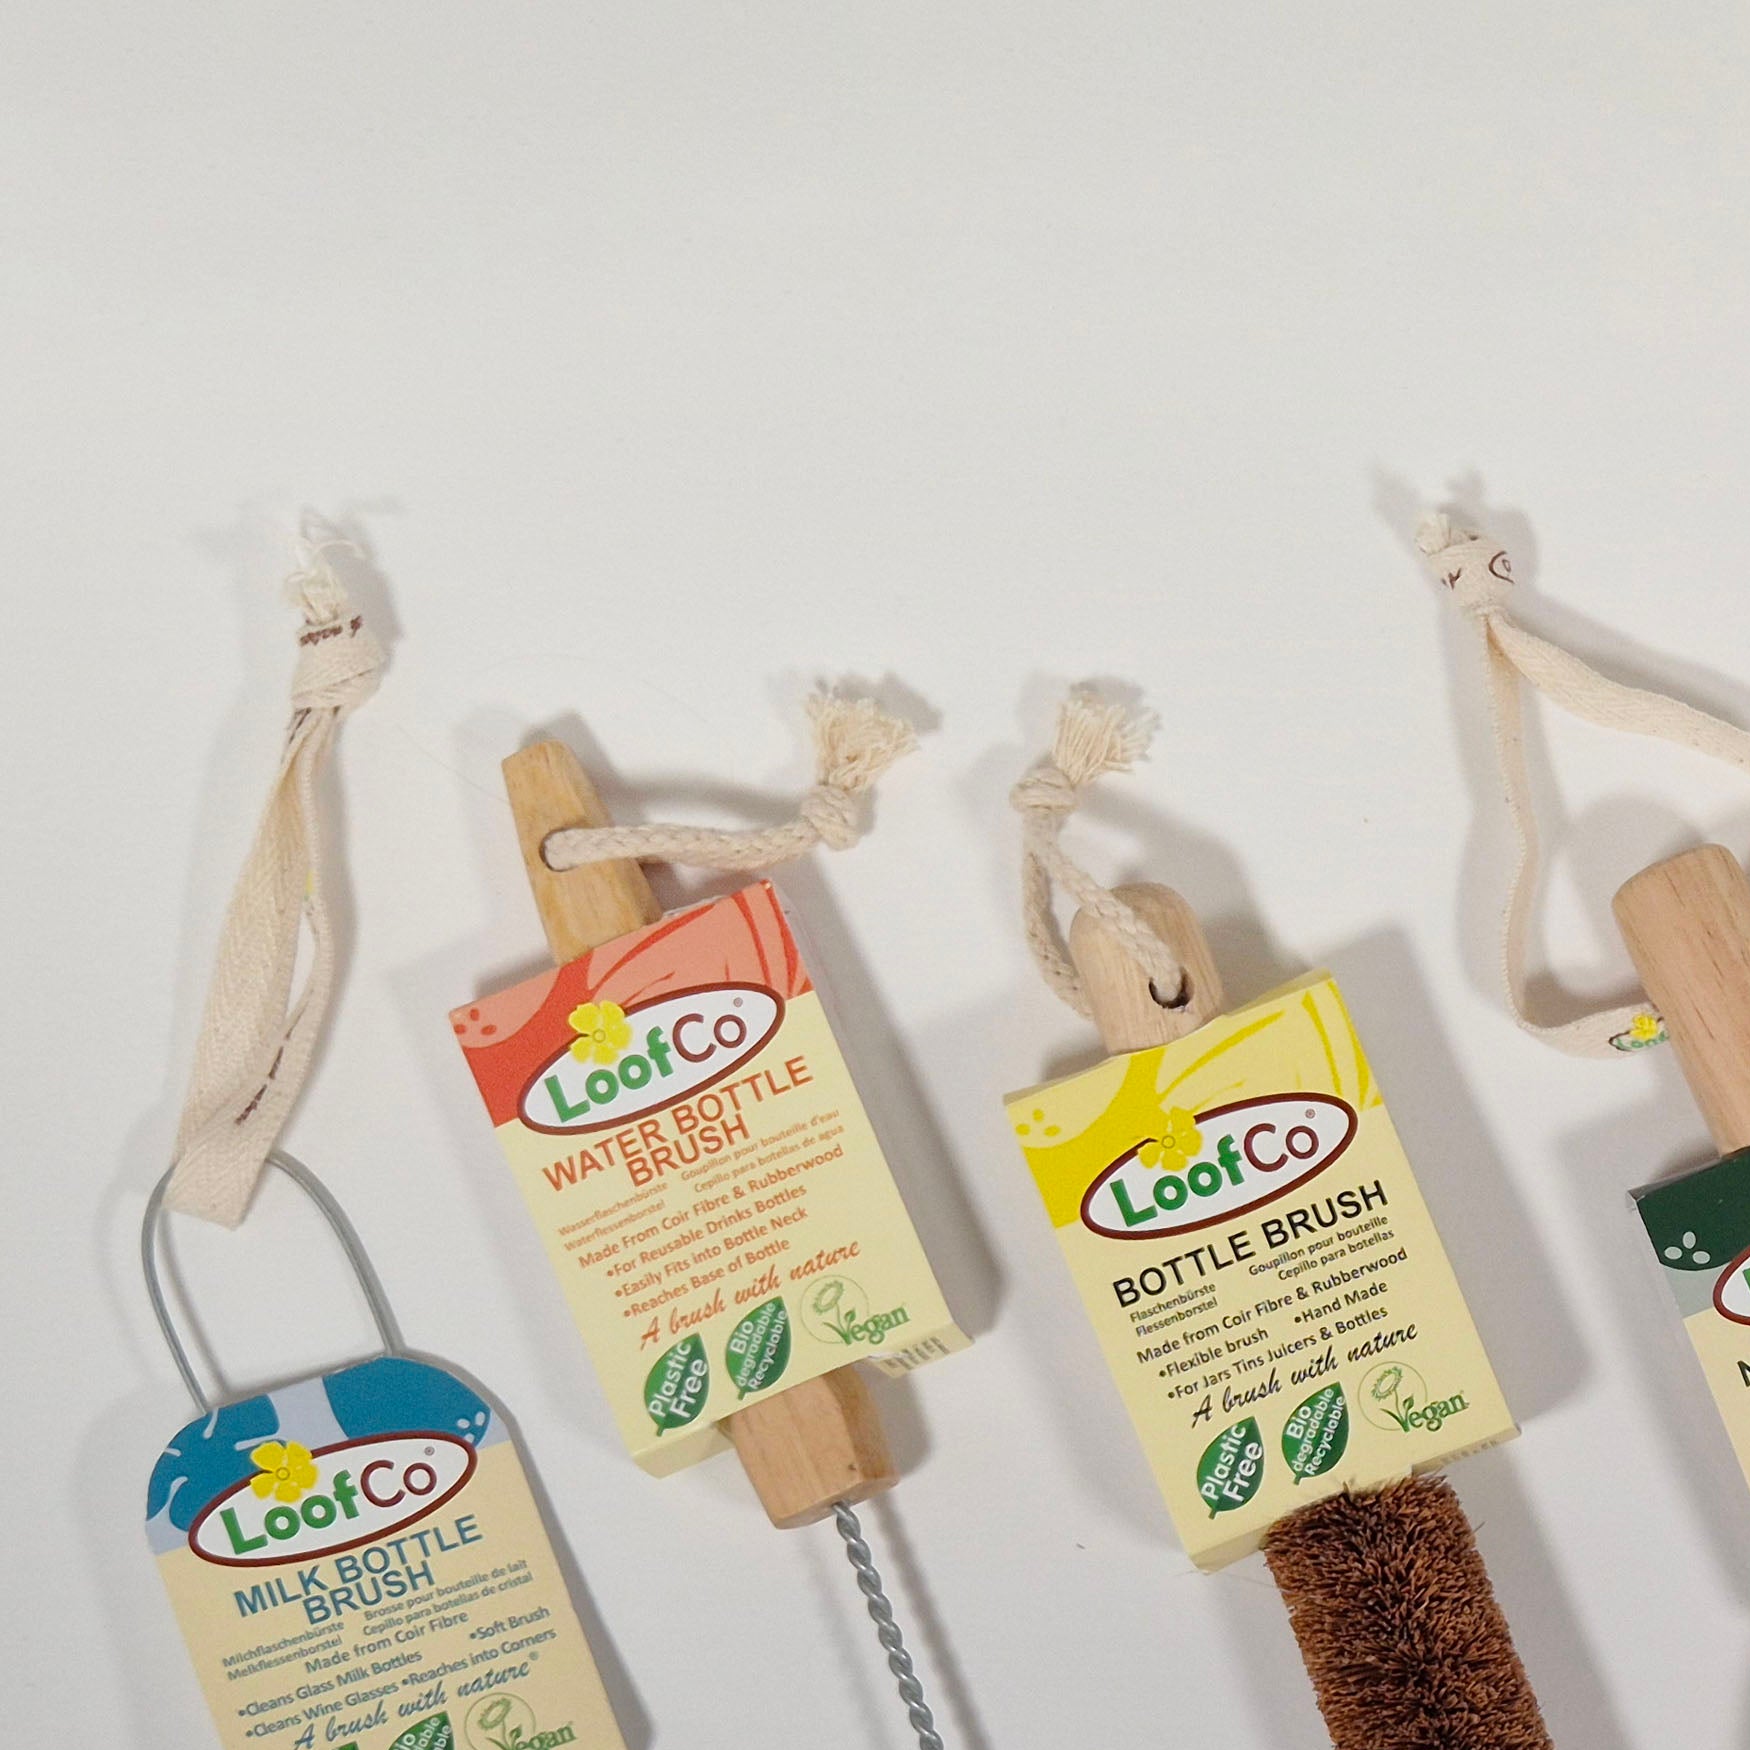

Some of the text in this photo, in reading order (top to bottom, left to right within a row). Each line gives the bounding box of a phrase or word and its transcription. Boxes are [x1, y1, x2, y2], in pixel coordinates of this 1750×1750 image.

[542, 1056, 812, 1191] WATER BOTTLE
[626, 1114, 748, 1186] BRUSH
[575, 1143, 846, 1269] Made From Coir Fibre & Rubberwood
[1112, 1180, 1387, 1307] BOTTLE BRUSH
[1248, 1216, 1387, 1276] Goupillon pour bouteille
[1277, 1230, 1394, 1281] Cepillo para botellas
[823, 1307, 909, 1345] Vegan
[1129, 1283, 1215, 1322] Flaschenbürste
[1135, 1296, 1217, 1336] Flessenborstel
[1136, 1247, 1407, 1363] Made from Coir Fibre & Rubberwood
[647, 1341, 691, 1417] Plastic
[669, 1358, 709, 1418] Free
[1286, 1405, 1312, 1439] Bio
[1292, 1389, 1334, 1471] degradable
[1305, 1397, 1348, 1476] Recyclable
[1381, 1394, 1468, 1432] Vegan
[234, 1514, 482, 1617] MILK BOTTLE
[303, 1561, 433, 1624] BRUSH
[302, 1607, 471, 1675] Made from Coir Fibre
[324, 1699, 388, 1742] brush
[397, 1680, 447, 1718] with
